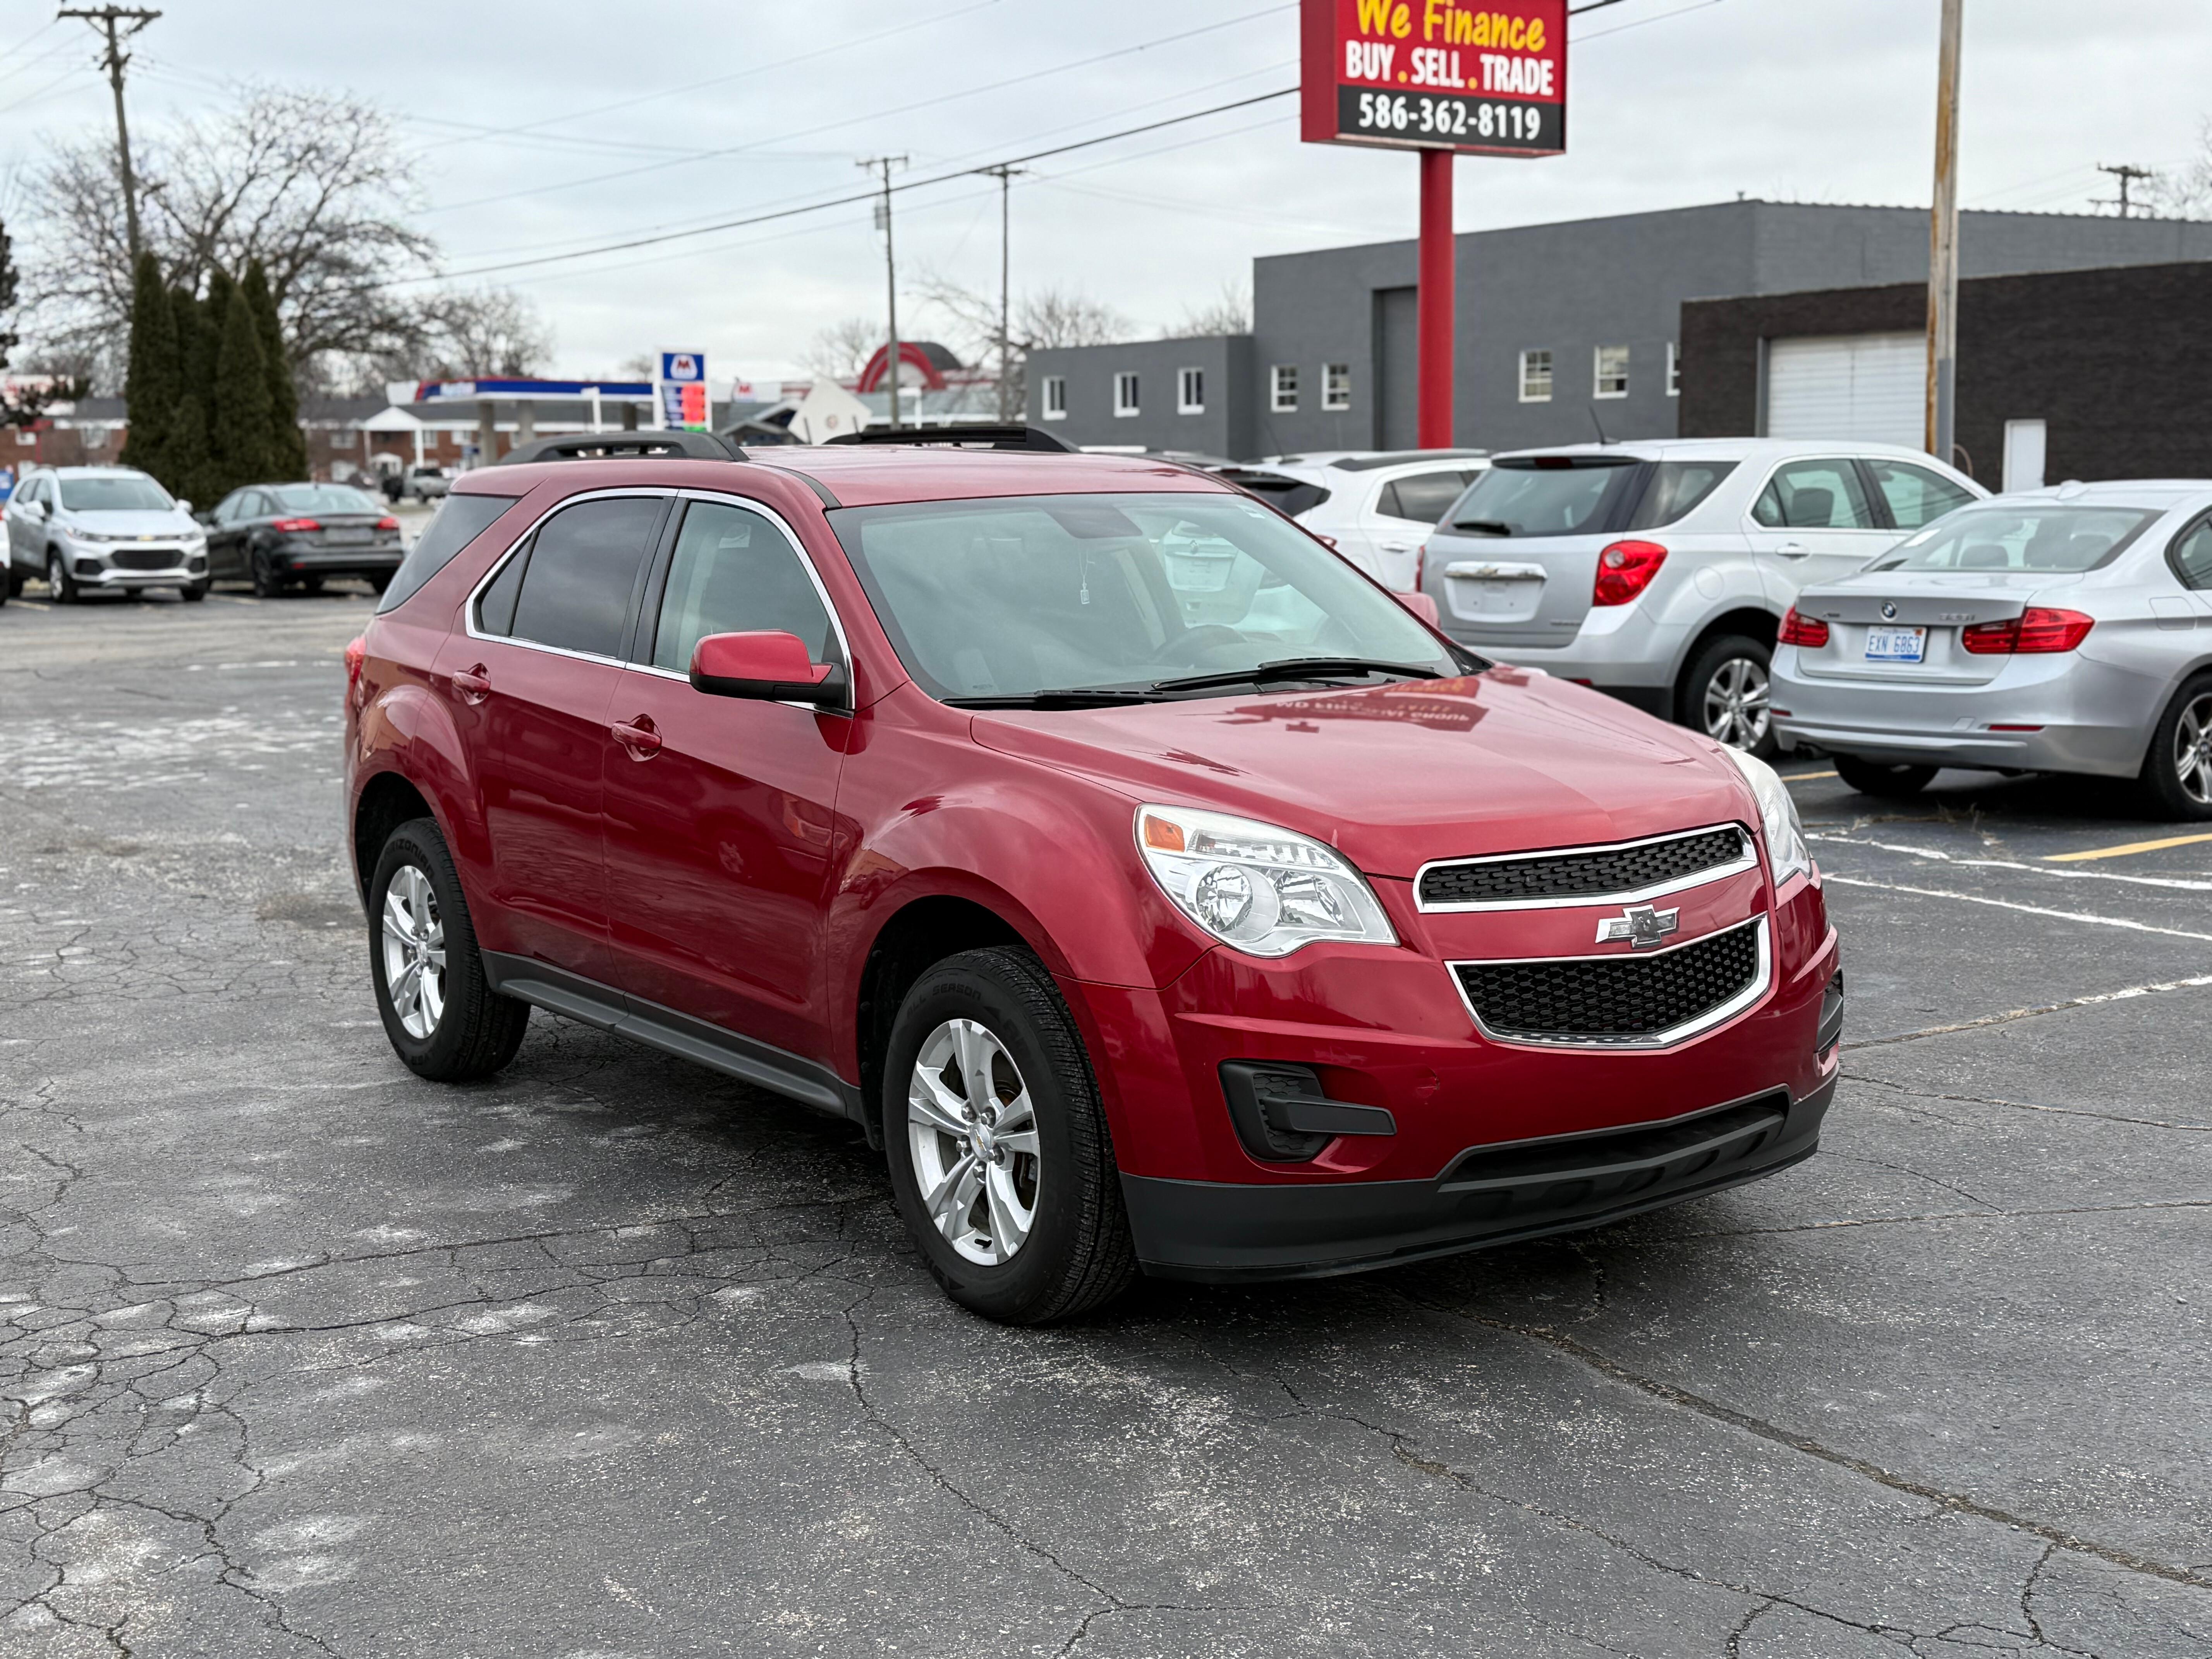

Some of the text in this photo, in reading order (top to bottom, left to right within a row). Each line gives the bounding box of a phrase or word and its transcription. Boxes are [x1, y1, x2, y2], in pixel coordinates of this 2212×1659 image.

[1357, 0, 1546, 52] We Finance
[1480, 53, 1554, 95] TRADE
[1359, 93, 1541, 140] 586-362-8119
[1868, 635, 1920, 653] EXN 6863
[933, 983, 982, 1001] SEASON
